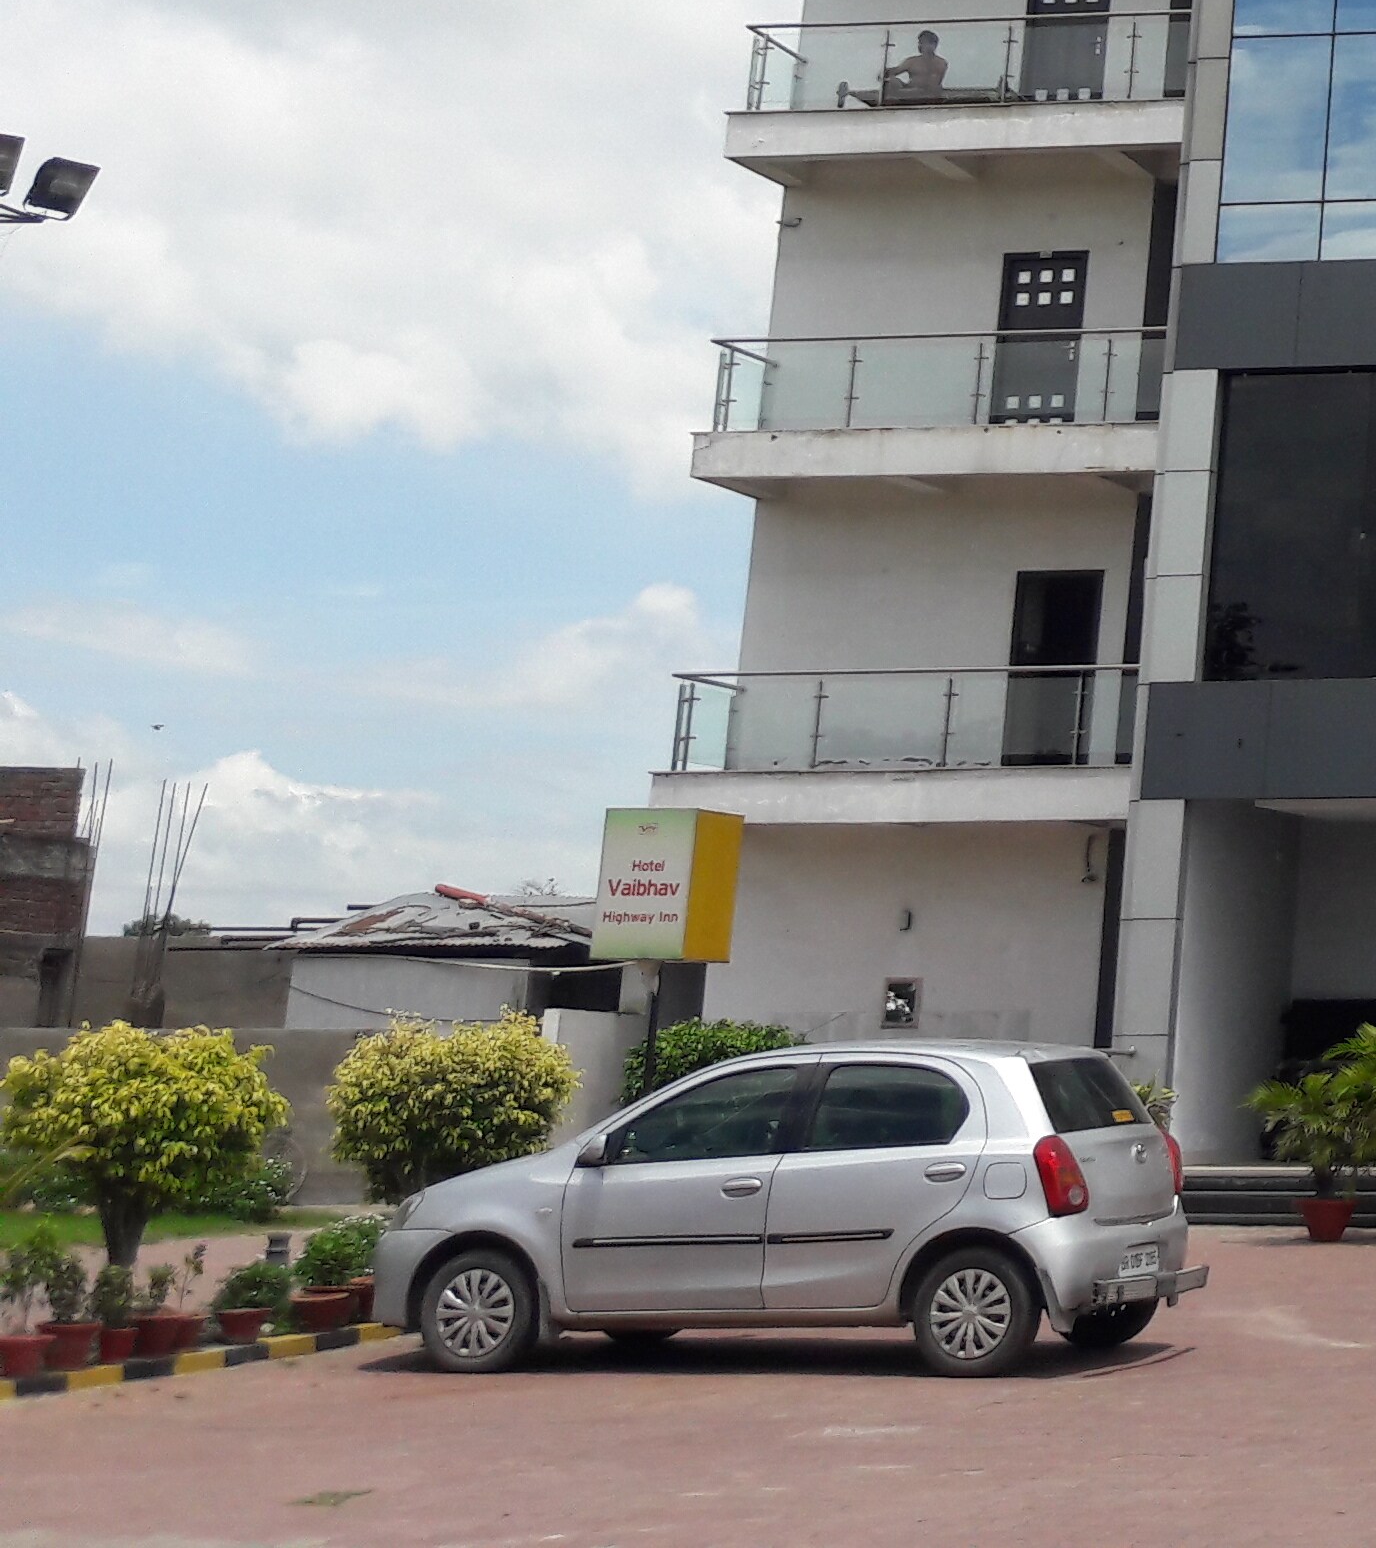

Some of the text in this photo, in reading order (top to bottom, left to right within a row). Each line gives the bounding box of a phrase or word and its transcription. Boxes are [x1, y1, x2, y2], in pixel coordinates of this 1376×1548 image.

[631, 859, 666, 872] Hotel
[608, 878, 681, 897] Vaibhav
[602, 911, 679, 926] Highway Inn
